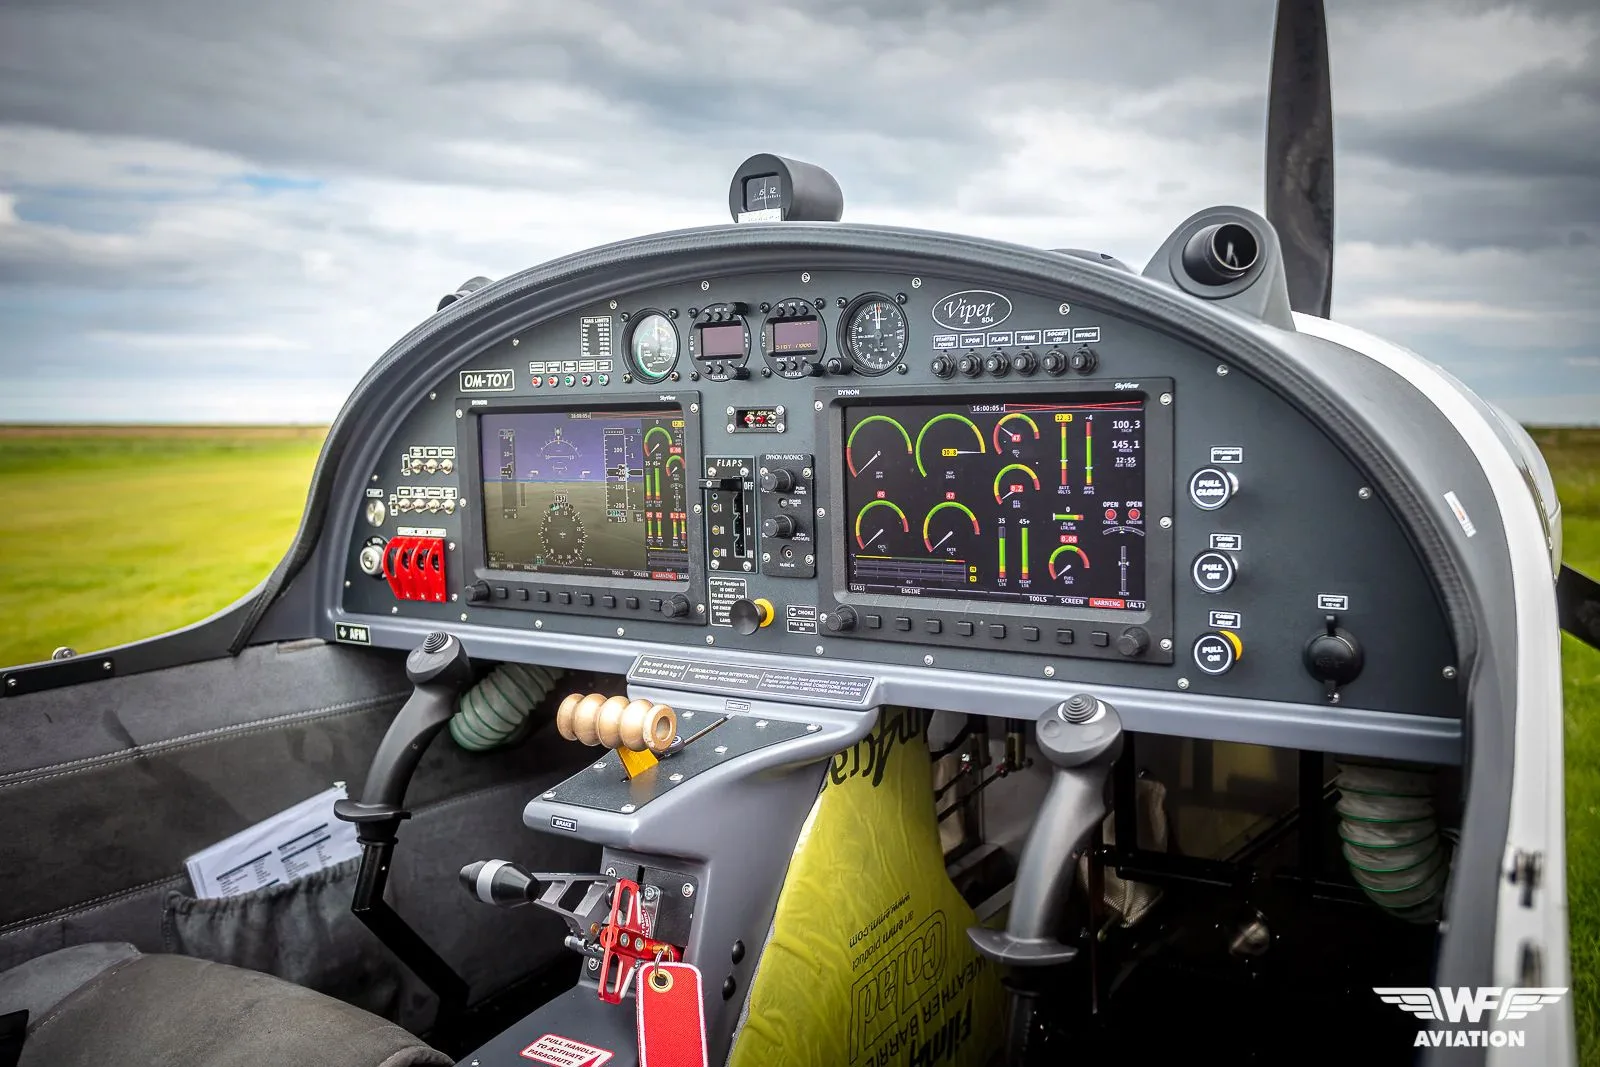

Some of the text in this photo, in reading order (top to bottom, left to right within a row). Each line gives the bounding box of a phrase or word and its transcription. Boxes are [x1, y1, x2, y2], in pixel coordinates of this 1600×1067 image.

[944, 298, 996, 324] Viper
[464, 373, 510, 388] OM-TOY
[1113, 420, 1140, 429] 100.3
[1112, 440, 1140, 448] 145.1
[744, 481, 754, 490] OFF
[350, 629, 366, 641] AFM
[544, 1037, 596, 1055] PULL HANDLE
[528, 1049, 574, 1065] PARACHUTE
[547, 1047, 585, 1061] ACTIVATE
